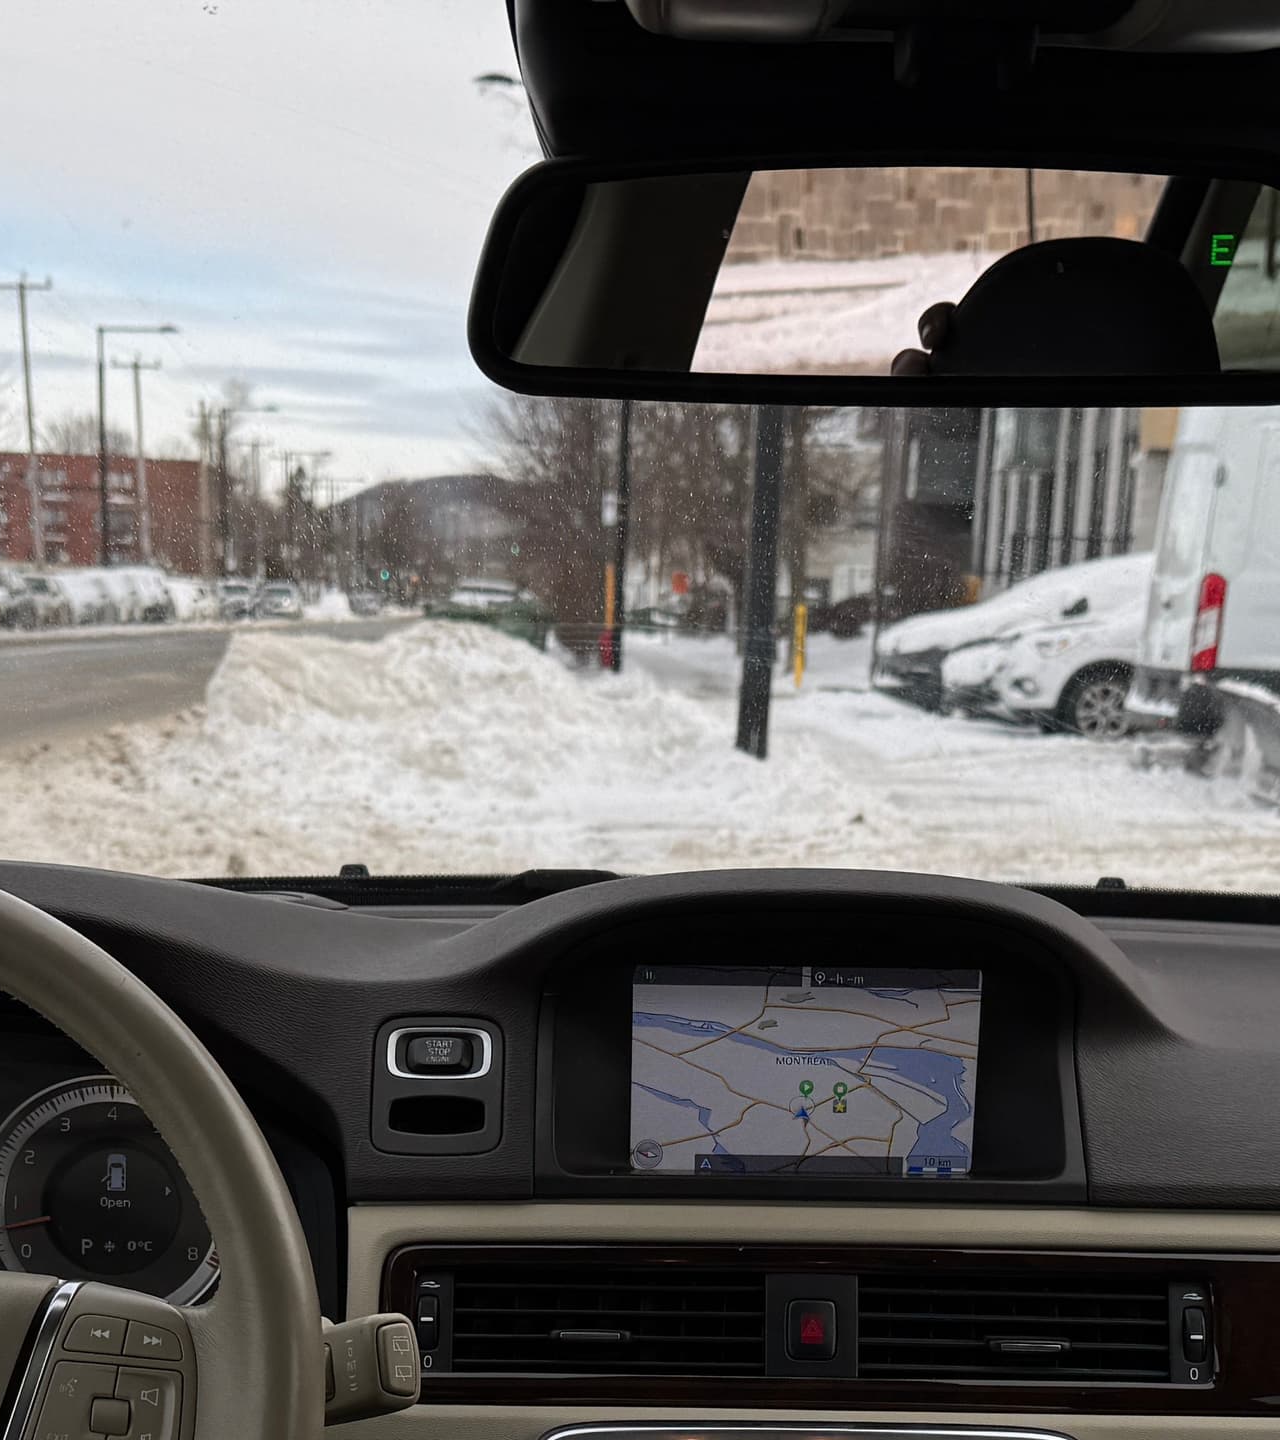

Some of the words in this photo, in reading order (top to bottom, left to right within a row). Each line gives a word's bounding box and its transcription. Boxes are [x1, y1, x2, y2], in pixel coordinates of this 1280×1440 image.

[1211, 234, 1234, 265] E
[425, 1040, 453, 1048] START
[428, 1048, 451, 1056] STOP
[107, 1106, 119, 1120] 4
[60, 1117, 71, 1132] 3
[24, 1150, 36, 1165] 2
[924, 1157, 935, 1166] 10
[938, 1158, 951, 1166] km
[99, 1197, 132, 1209] Open
[21, 1244, 32, 1258] 0
[81, 1239, 93, 1255] P
[127, 1240, 153, 1252] 0°C
[187, 1247, 199, 1261] 8
[423, 1355, 432, 1368] 0
[1190, 1367, 1199, 1381] 0
